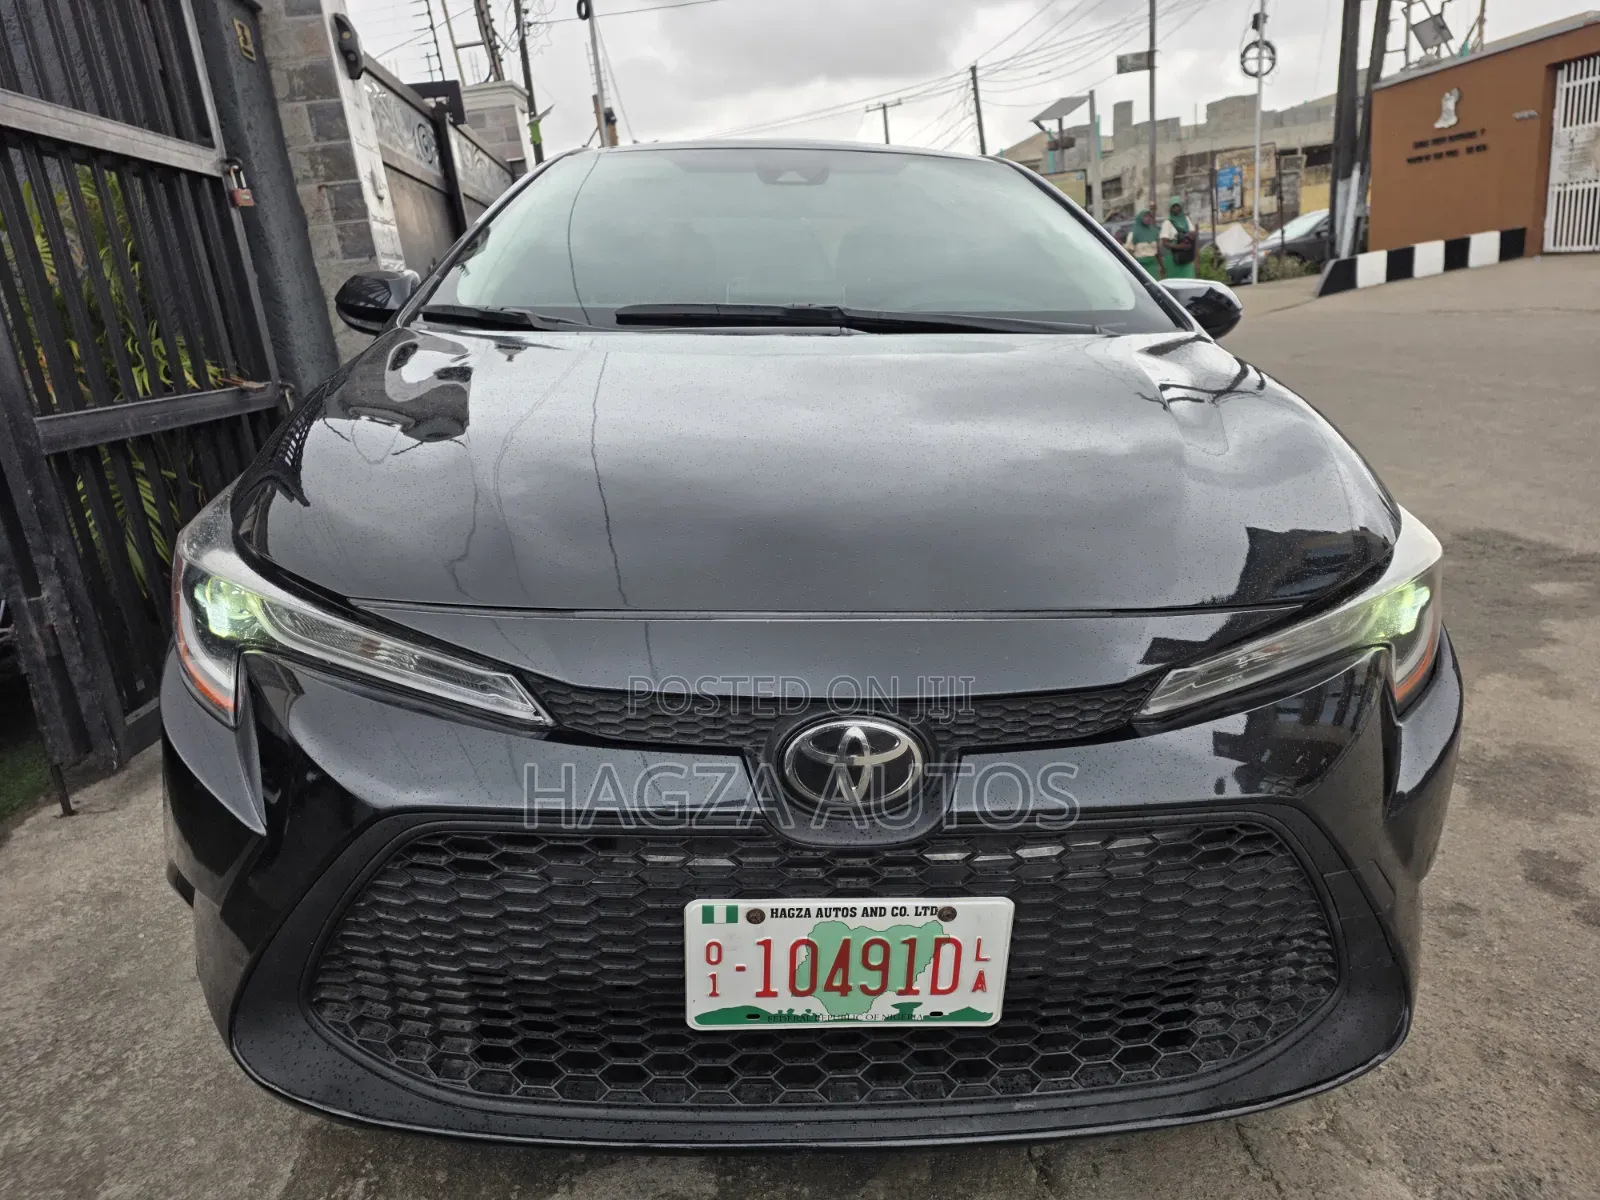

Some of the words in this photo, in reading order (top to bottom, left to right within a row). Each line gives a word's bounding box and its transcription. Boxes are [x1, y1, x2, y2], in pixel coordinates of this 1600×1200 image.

[770, 907, 812, 919] HAGZA
[815, 906, 857, 918] AUTOS
[861, 906, 887, 918] AND
[891, 905, 910, 917] CO.
[914, 905, 938, 917] LTD
[767, 1015, 812, 1023] FEDERAL
[816, 1013, 863, 1022] REPUBLIC
[865, 1013, 879, 1021] OF
[881, 1013, 924, 1021] NIGERIA
